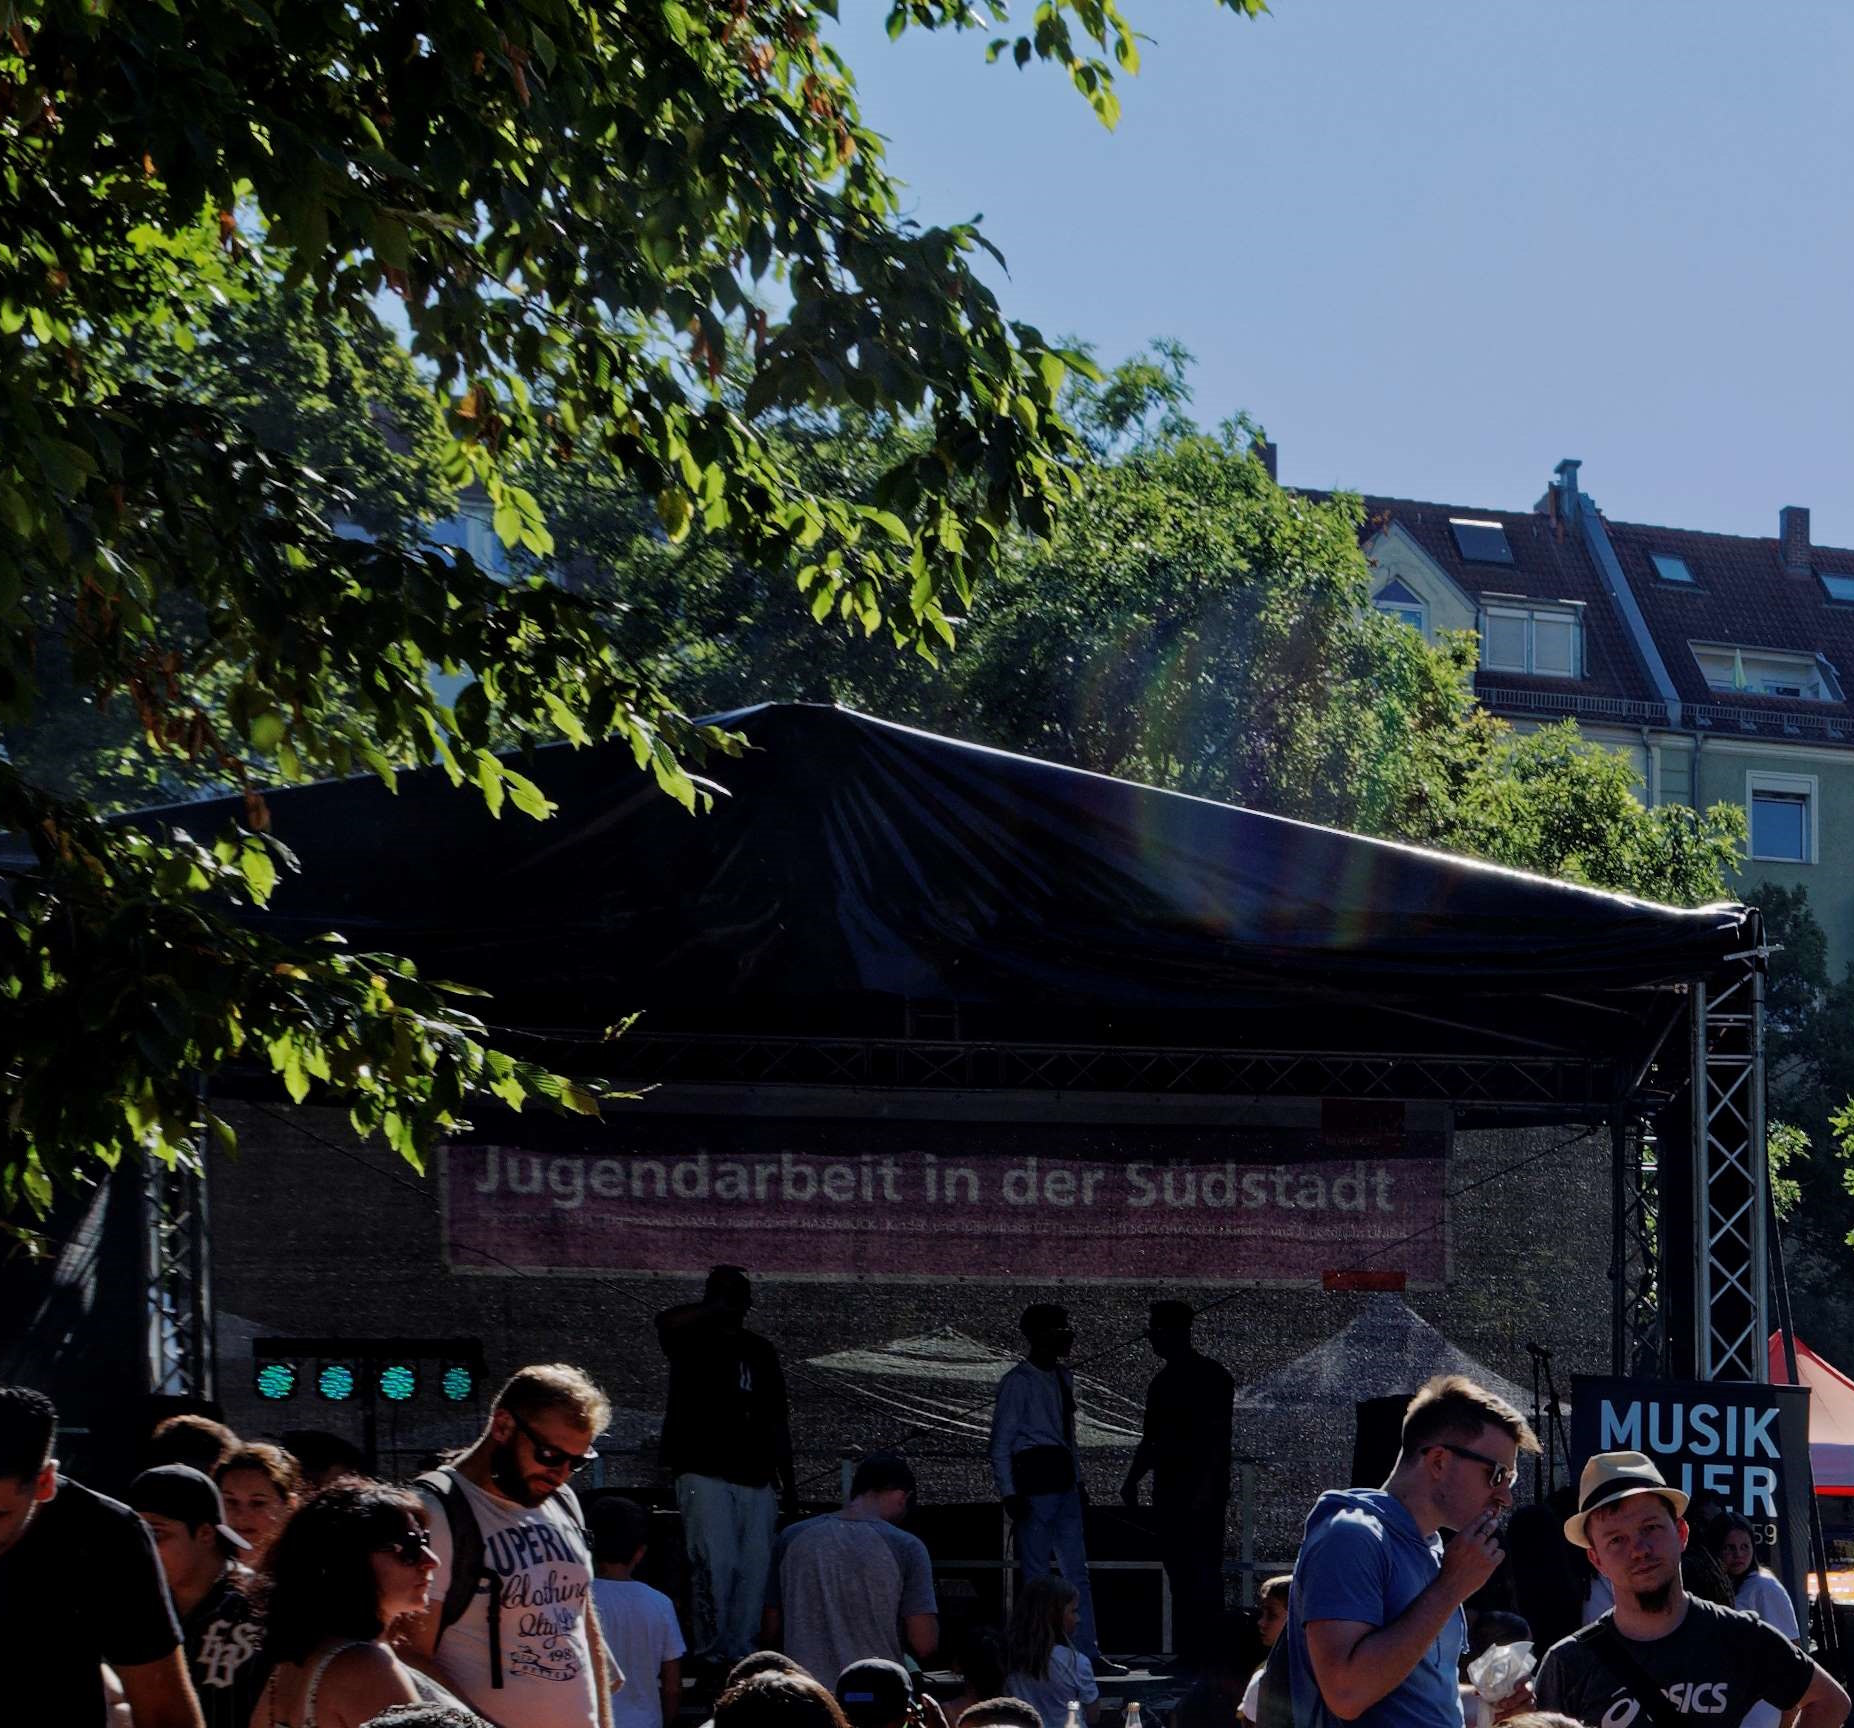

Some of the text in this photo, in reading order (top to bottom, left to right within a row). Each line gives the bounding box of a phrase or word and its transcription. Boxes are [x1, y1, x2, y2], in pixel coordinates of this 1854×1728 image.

[474, 1145, 904, 1209] Jugendarbeit
[923, 1151, 981, 1203] in
[1000, 1156, 1103, 1206] der
[1600, 1399, 1782, 1459] MUSIK
[1681, 1463, 1779, 1518] IER
[1660, 1682, 1729, 1714] SICS
